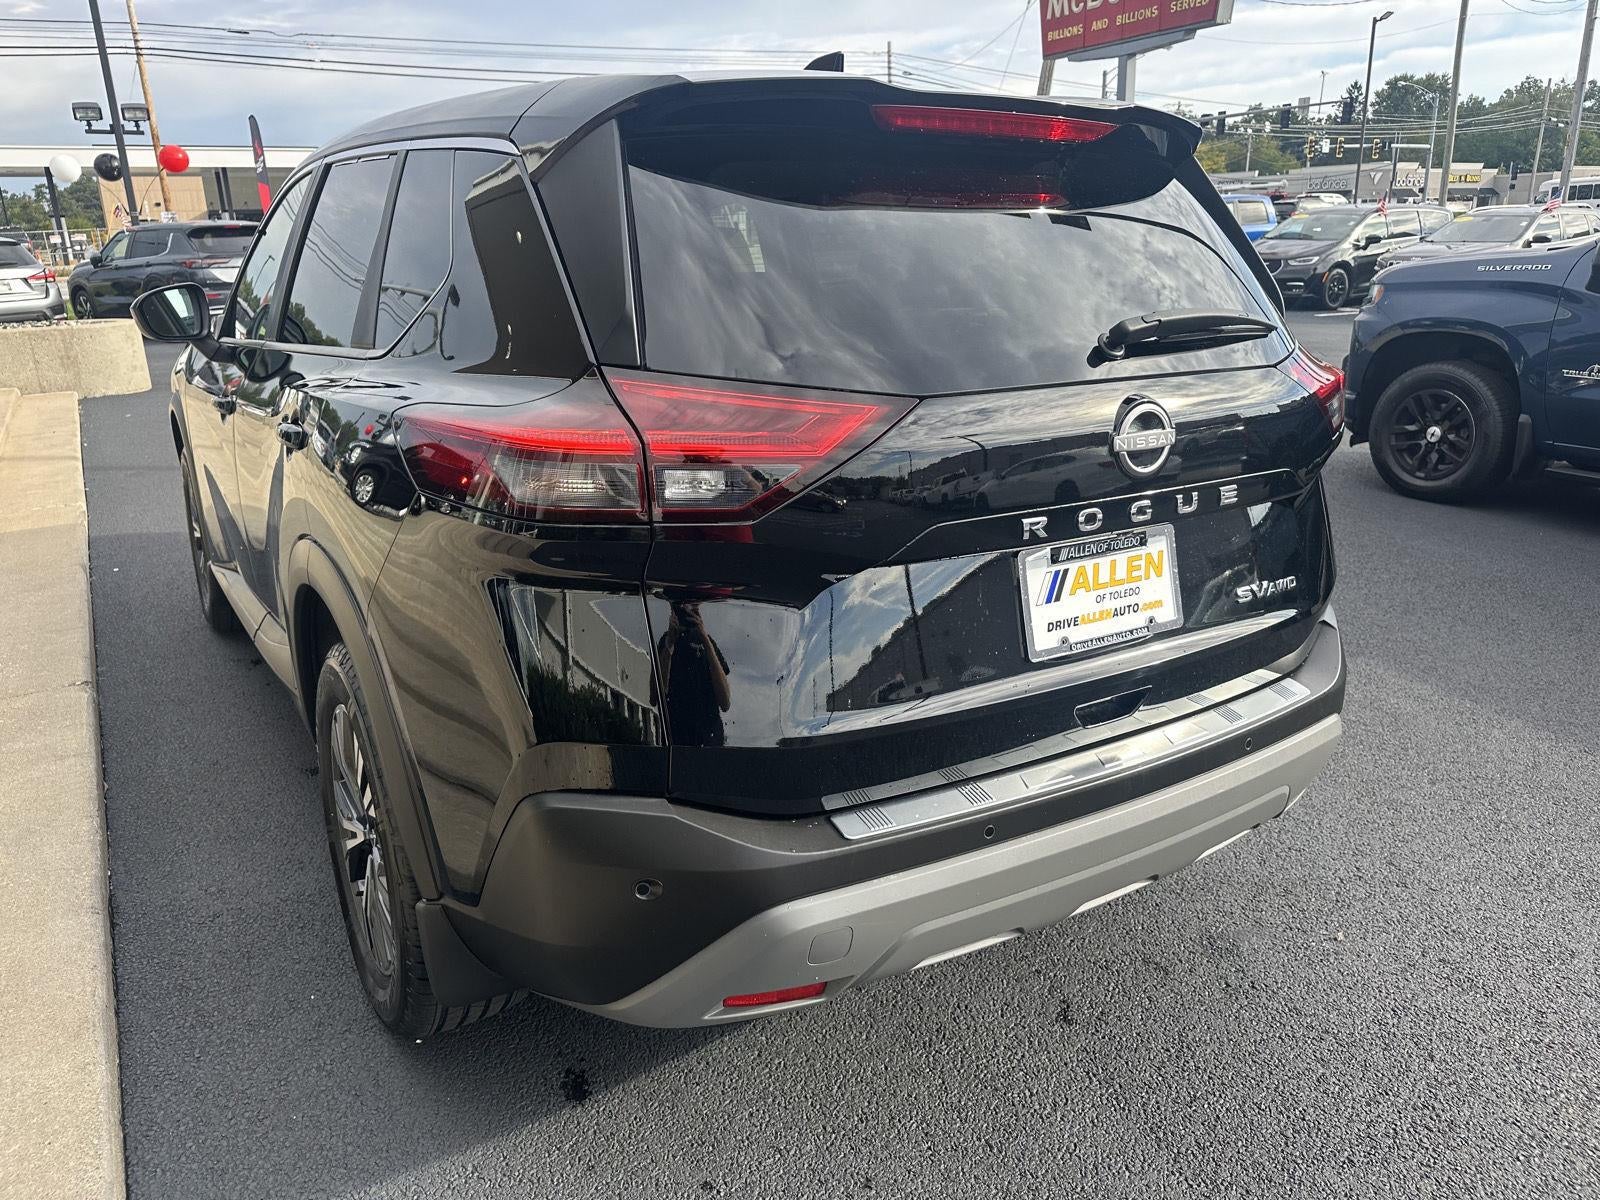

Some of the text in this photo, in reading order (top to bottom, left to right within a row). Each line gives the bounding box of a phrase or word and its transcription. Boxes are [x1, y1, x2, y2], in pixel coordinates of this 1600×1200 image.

[1047, 23, 1084, 41] BILLIONS
[1091, 18, 1109, 32] AND
[1115, 5, 1159, 26] BILLIONS
[1116, 433, 1175, 450] NISSAN
[1021, 484, 1239, 540] ROGUE
[1068, 536, 1141, 559] ALLEN OF TOLEDO
[1069, 550, 1164, 596] ALLEN
[1095, 586, 1141, 604] OF TOLEDO
[1047, 599, 1163, 633] DRIVEALLENAUTO.com
[1071, 627, 1149, 651] DRIVEALLENAUTO.COM
